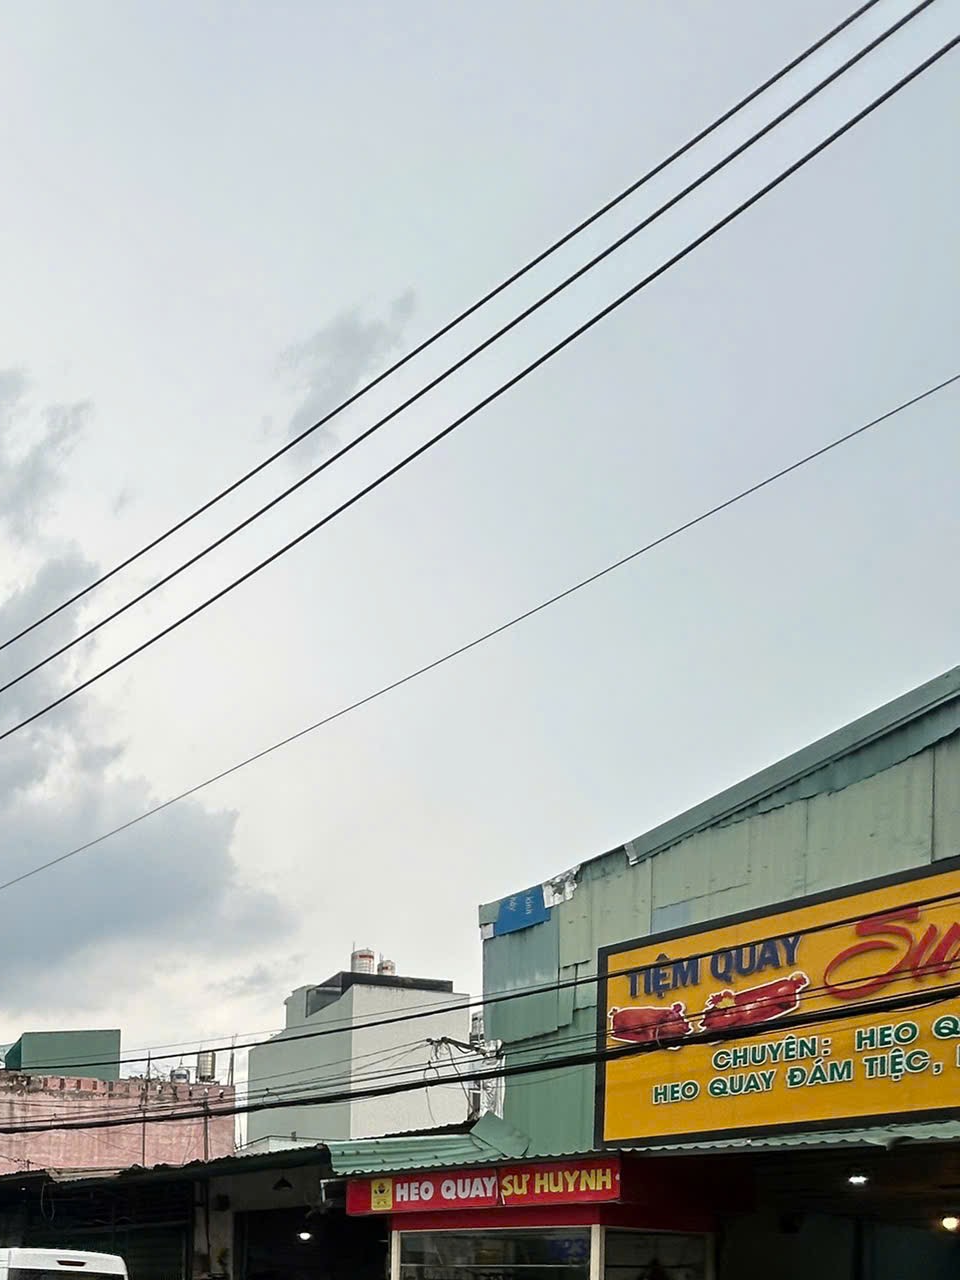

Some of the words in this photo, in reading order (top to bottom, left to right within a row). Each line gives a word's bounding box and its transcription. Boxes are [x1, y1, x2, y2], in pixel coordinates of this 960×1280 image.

[627, 953, 701, 998] TIỆM
[709, 936, 803, 983] QUAY
[712, 1035, 831, 1071] CHUYÊN:
[855, 1021, 919, 1052] HEO
[652, 1080, 700, 1104] HEO
[708, 1070, 777, 1098] QUAY
[787, 1058, 852, 1087] ĐÁM
[864, 1048, 943, 1084] TIỆC,
[395, 1181, 434, 1202] HEO
[441, 1175, 497, 1201] QUAY
[501, 1174, 529, 1197] SƯ
[535, 1168, 612, 1193] HUYNH
